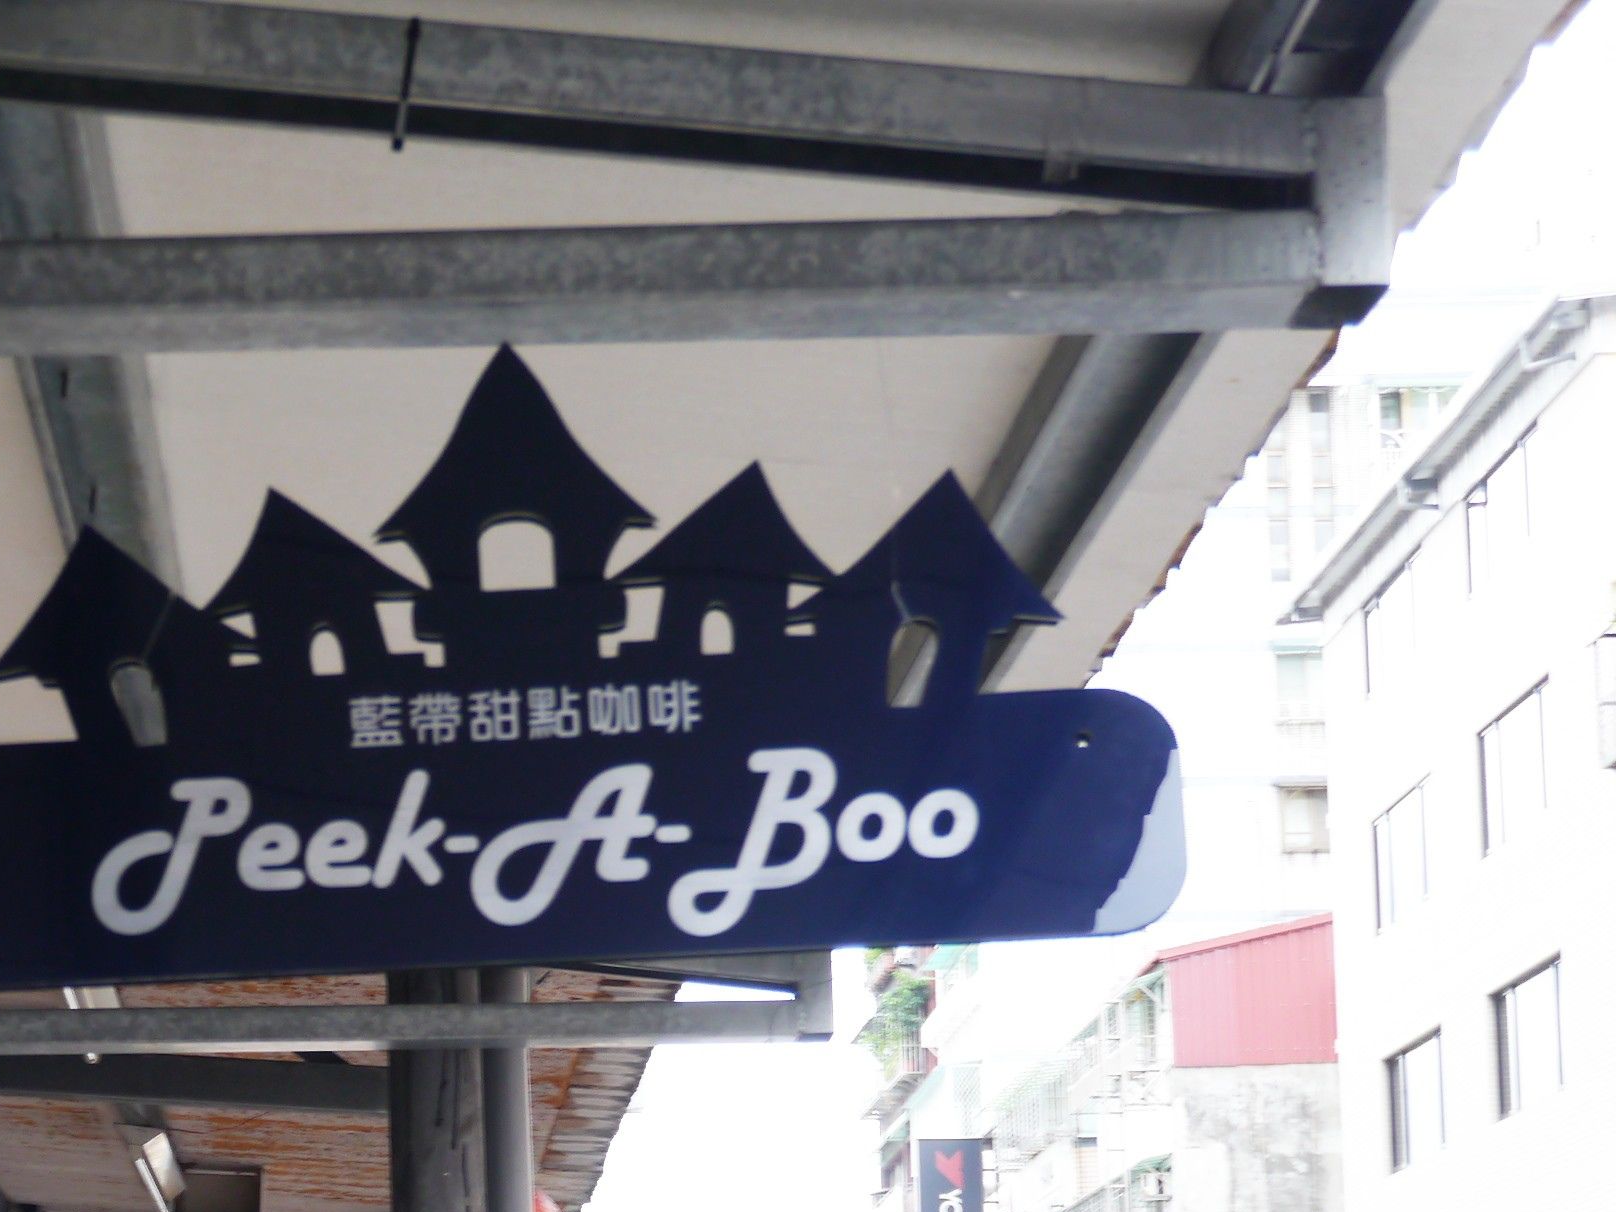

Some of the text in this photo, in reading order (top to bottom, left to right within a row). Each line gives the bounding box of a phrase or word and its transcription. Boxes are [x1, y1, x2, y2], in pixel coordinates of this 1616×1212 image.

[349, 681, 702, 747] 藍帶甜點咖啡
[91, 747, 980, 936] Peek-A-Boo
